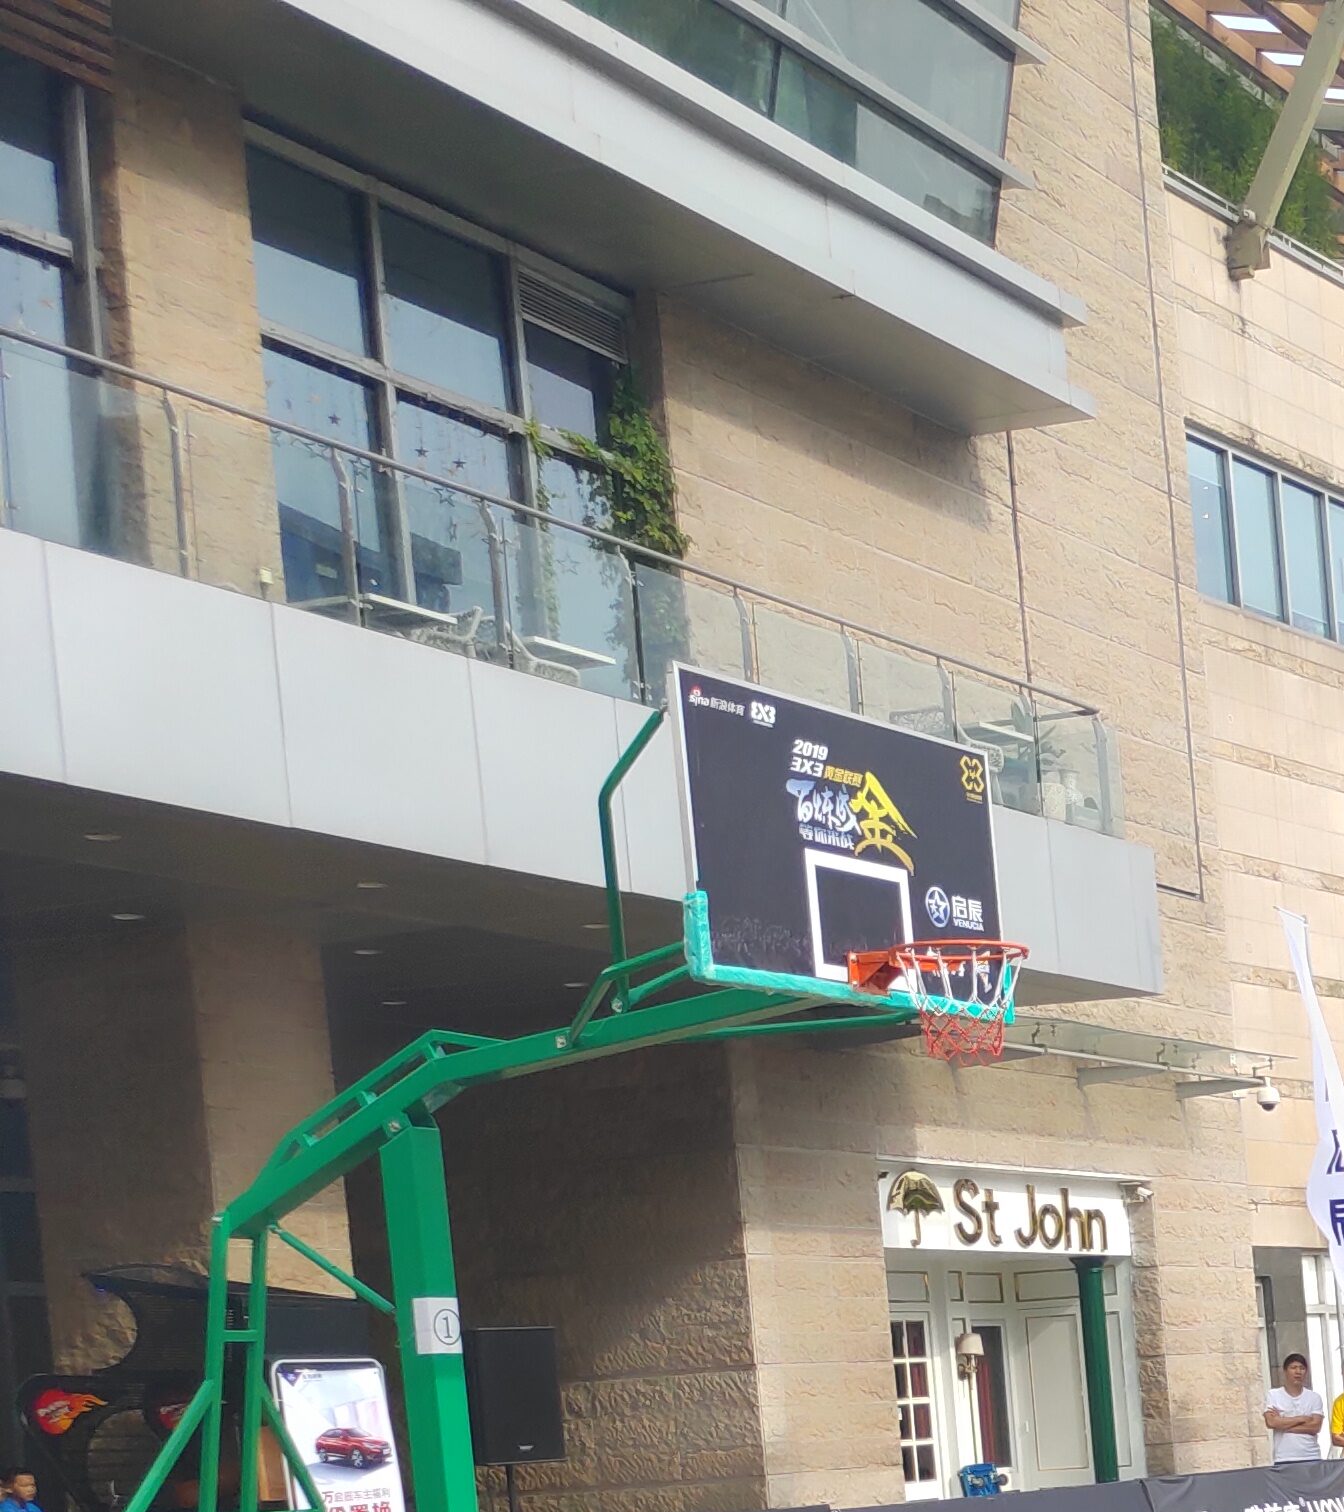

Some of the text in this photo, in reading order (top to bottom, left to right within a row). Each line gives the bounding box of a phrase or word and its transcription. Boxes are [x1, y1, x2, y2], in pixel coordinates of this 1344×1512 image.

[792, 739, 829, 761] 2019
[951, 895, 984, 922] 启辰
[953, 917, 985, 932] VENUCIA
[954, 1178, 1108, 1252] St John
